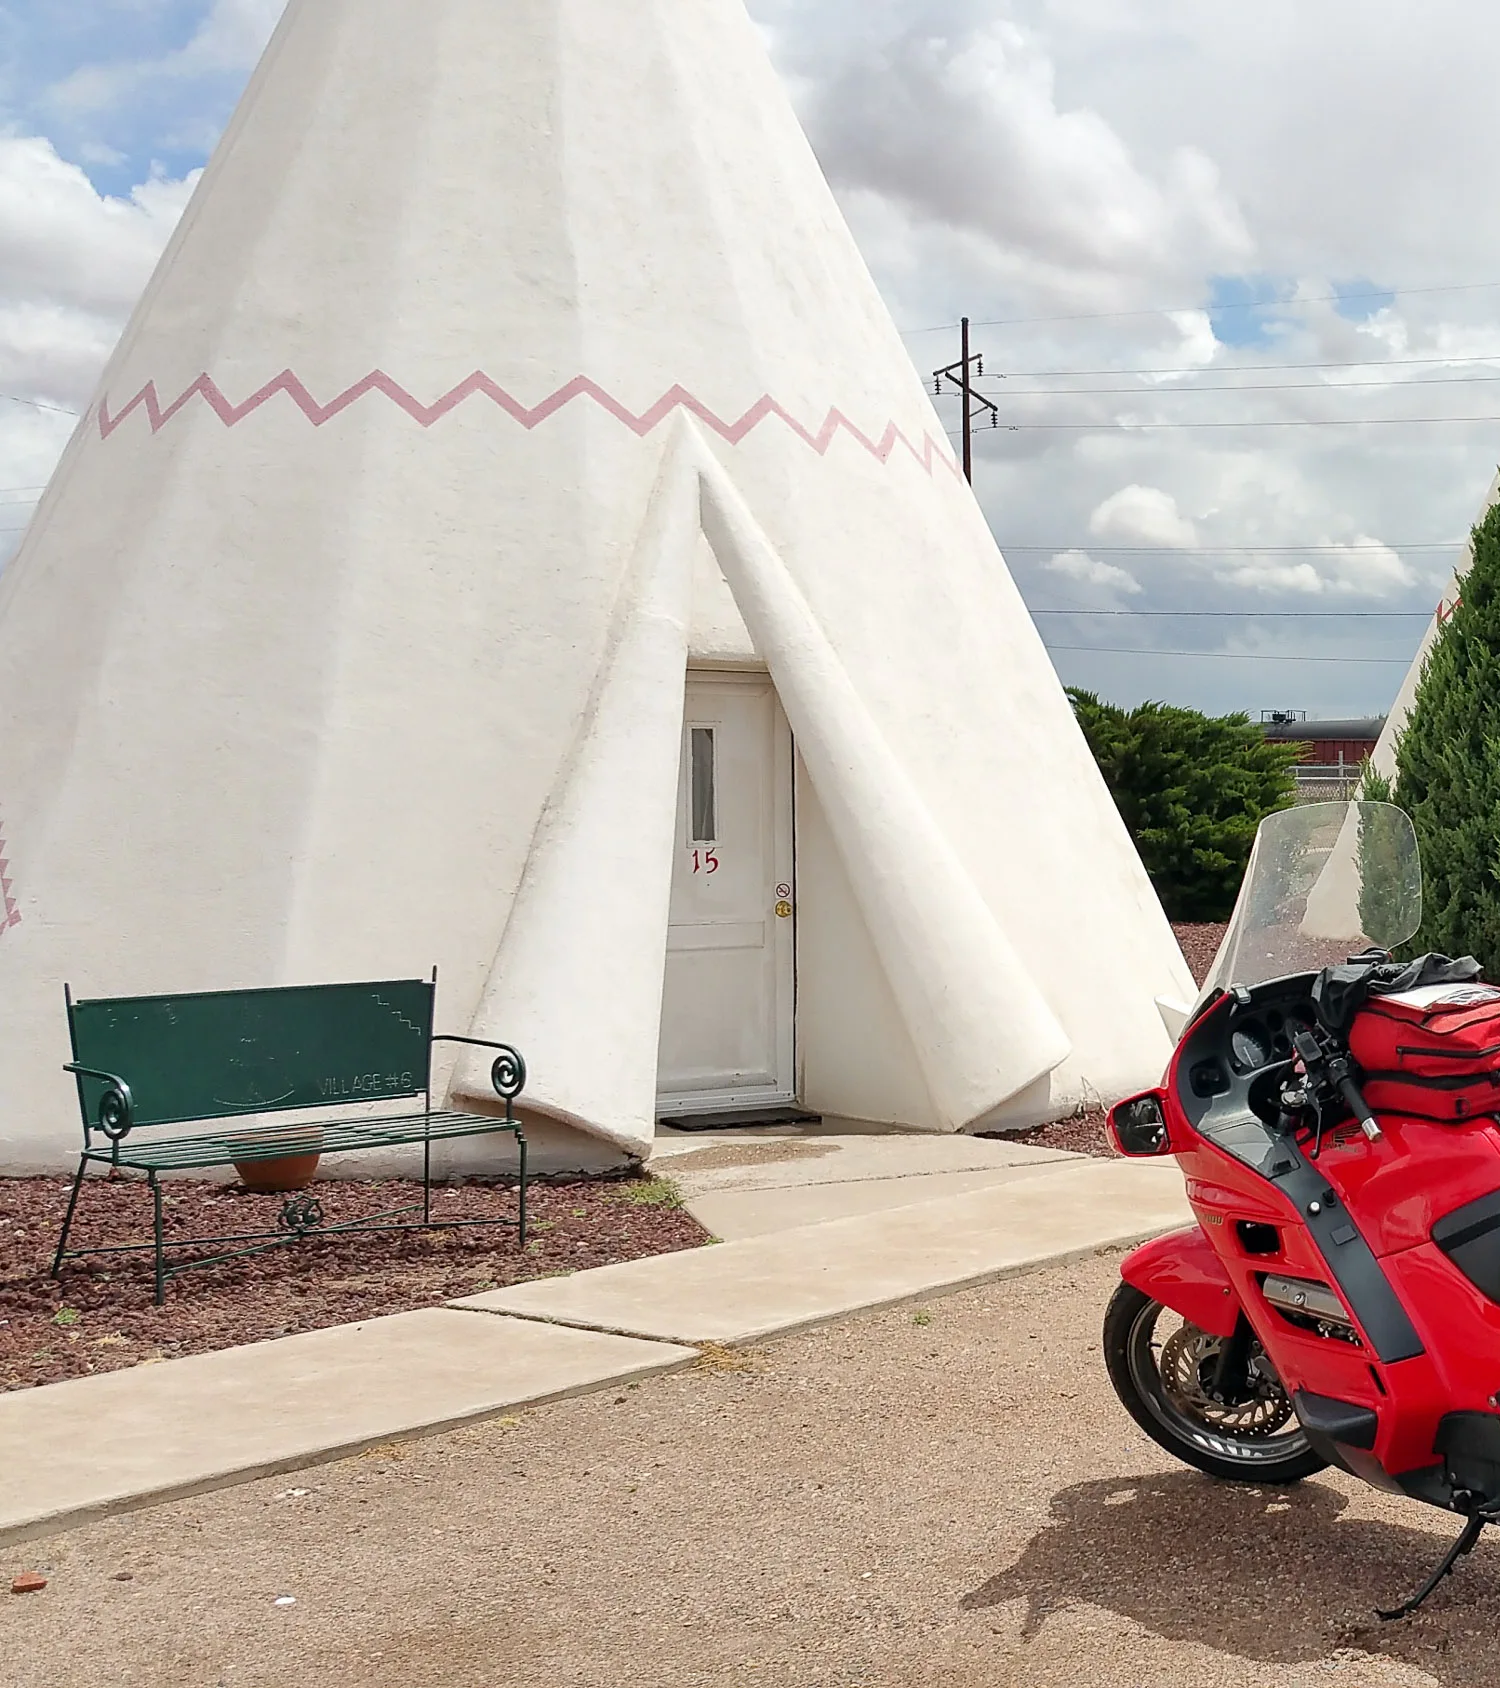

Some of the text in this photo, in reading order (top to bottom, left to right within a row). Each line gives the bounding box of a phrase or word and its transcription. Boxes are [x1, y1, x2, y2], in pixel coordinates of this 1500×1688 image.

[692, 847, 719, 874] 15
[316, 1071, 413, 1096] VILLAGE #6
